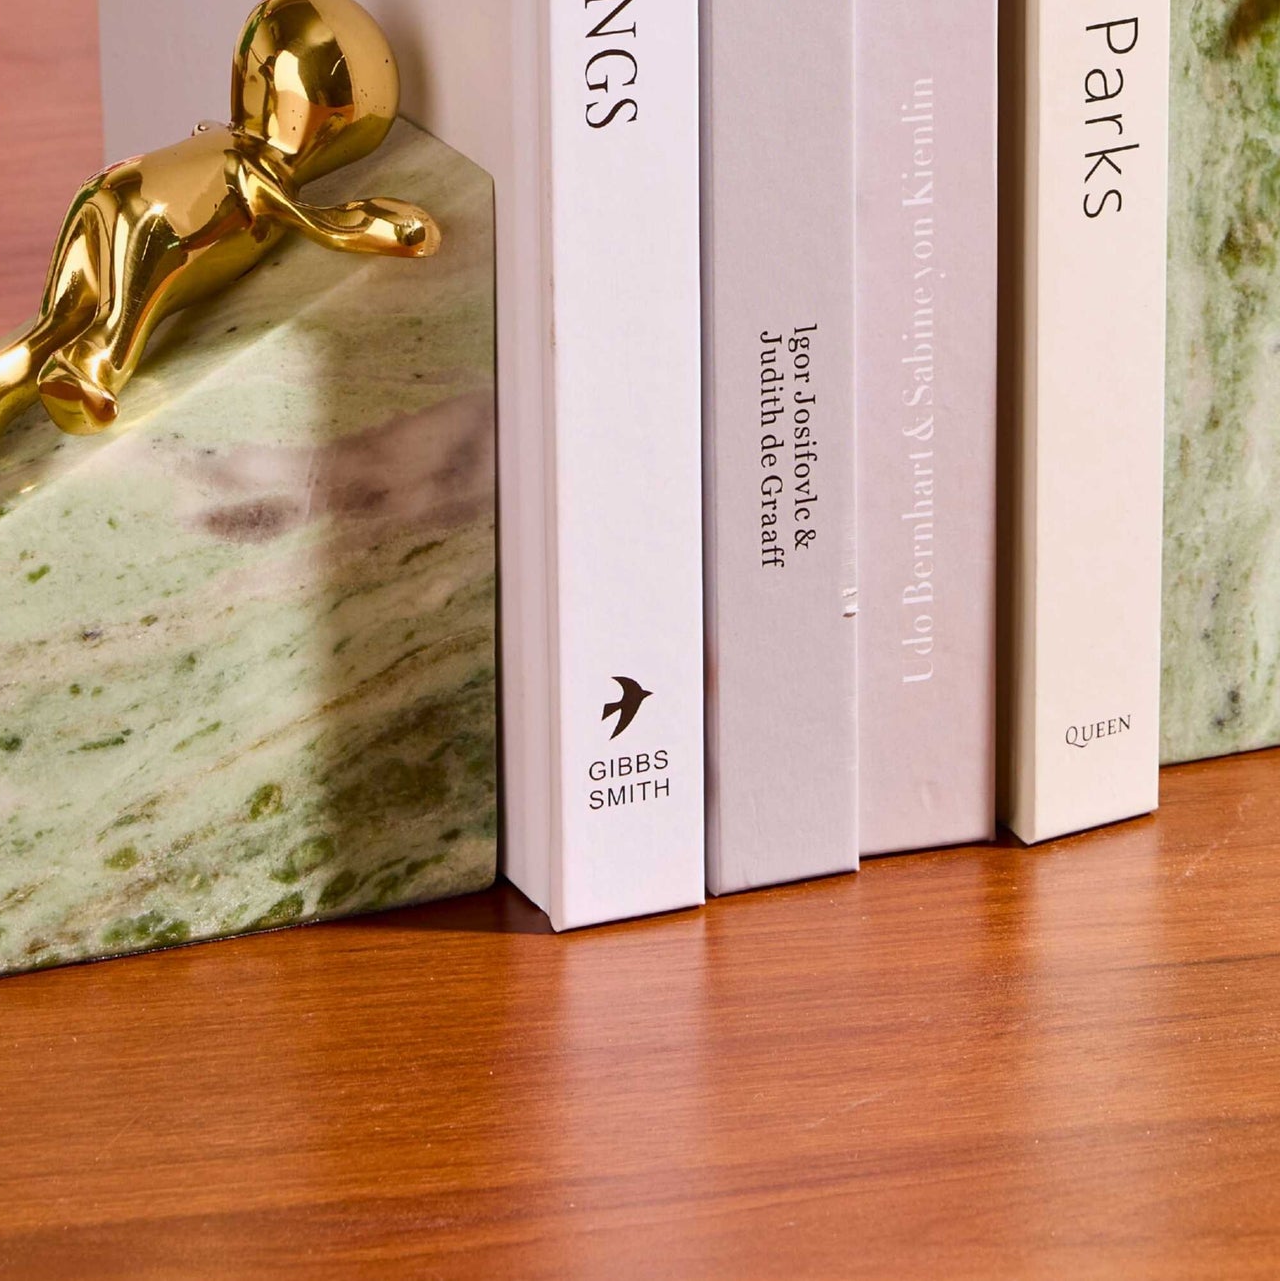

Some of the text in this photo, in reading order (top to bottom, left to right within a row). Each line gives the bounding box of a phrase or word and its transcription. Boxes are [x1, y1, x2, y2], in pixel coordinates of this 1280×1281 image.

[901, 78, 935, 208] Kienlin
[1082, 16, 1140, 219] Parks
[902, 288, 935, 408] Sabine
[759, 330, 785, 569] Judith de Graaff
[902, 415, 935, 442] &
[793, 528, 817, 551] &
[902, 451, 935, 606] Bernhart
[902, 615, 935, 684] Udo
[588, 749, 669, 781] GIBBS
[1065, 714, 1131, 749] QUEEN
[588, 777, 670, 810] SMITH
